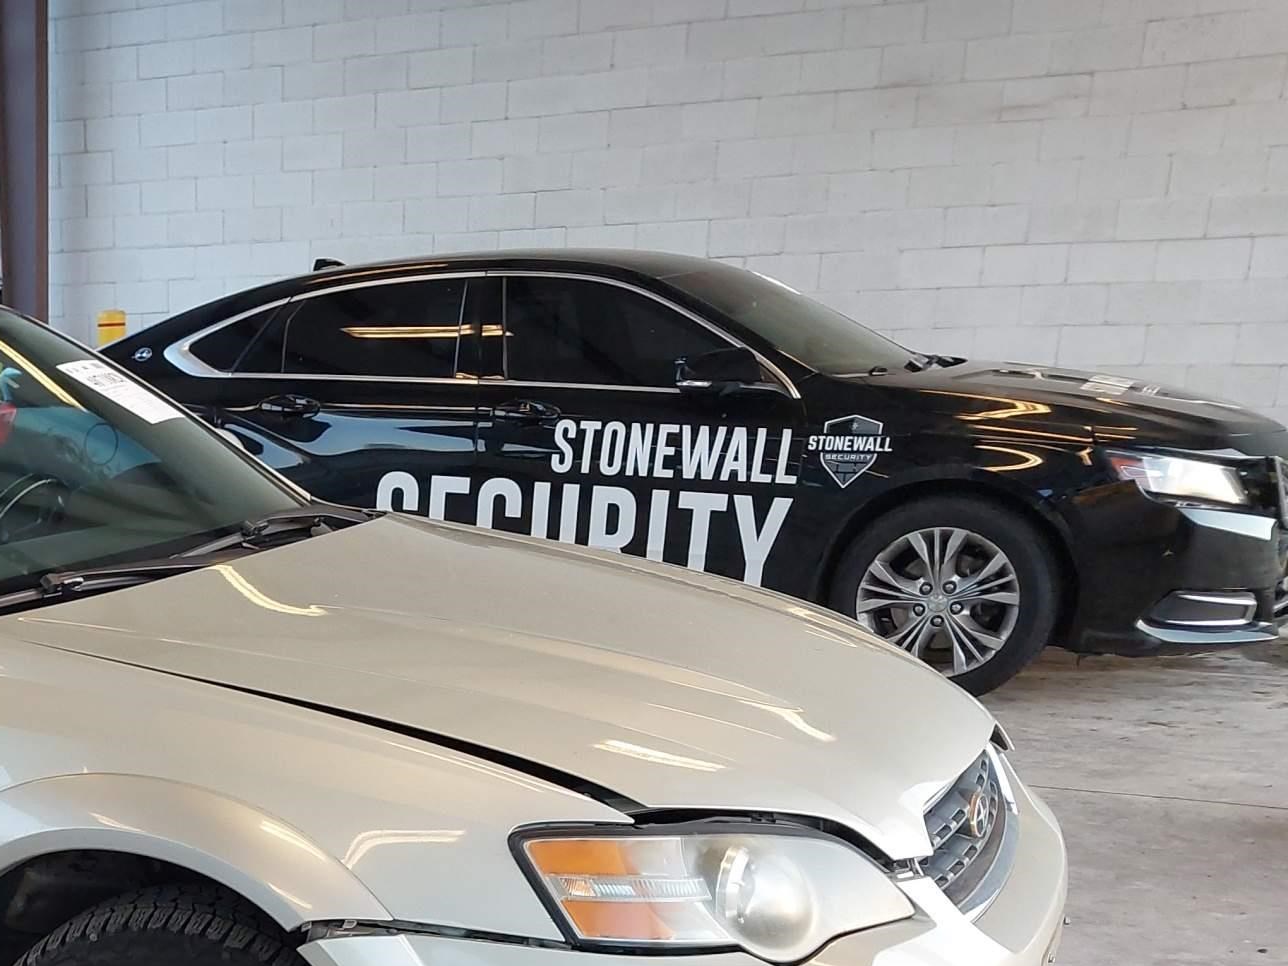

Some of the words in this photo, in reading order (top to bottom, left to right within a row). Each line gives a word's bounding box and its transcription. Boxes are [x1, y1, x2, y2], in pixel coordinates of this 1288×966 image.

[550, 419, 799, 485] STONEWALL
[807, 435, 893, 452] STONEWALL
[825, 453, 872, 461] SECURITY
